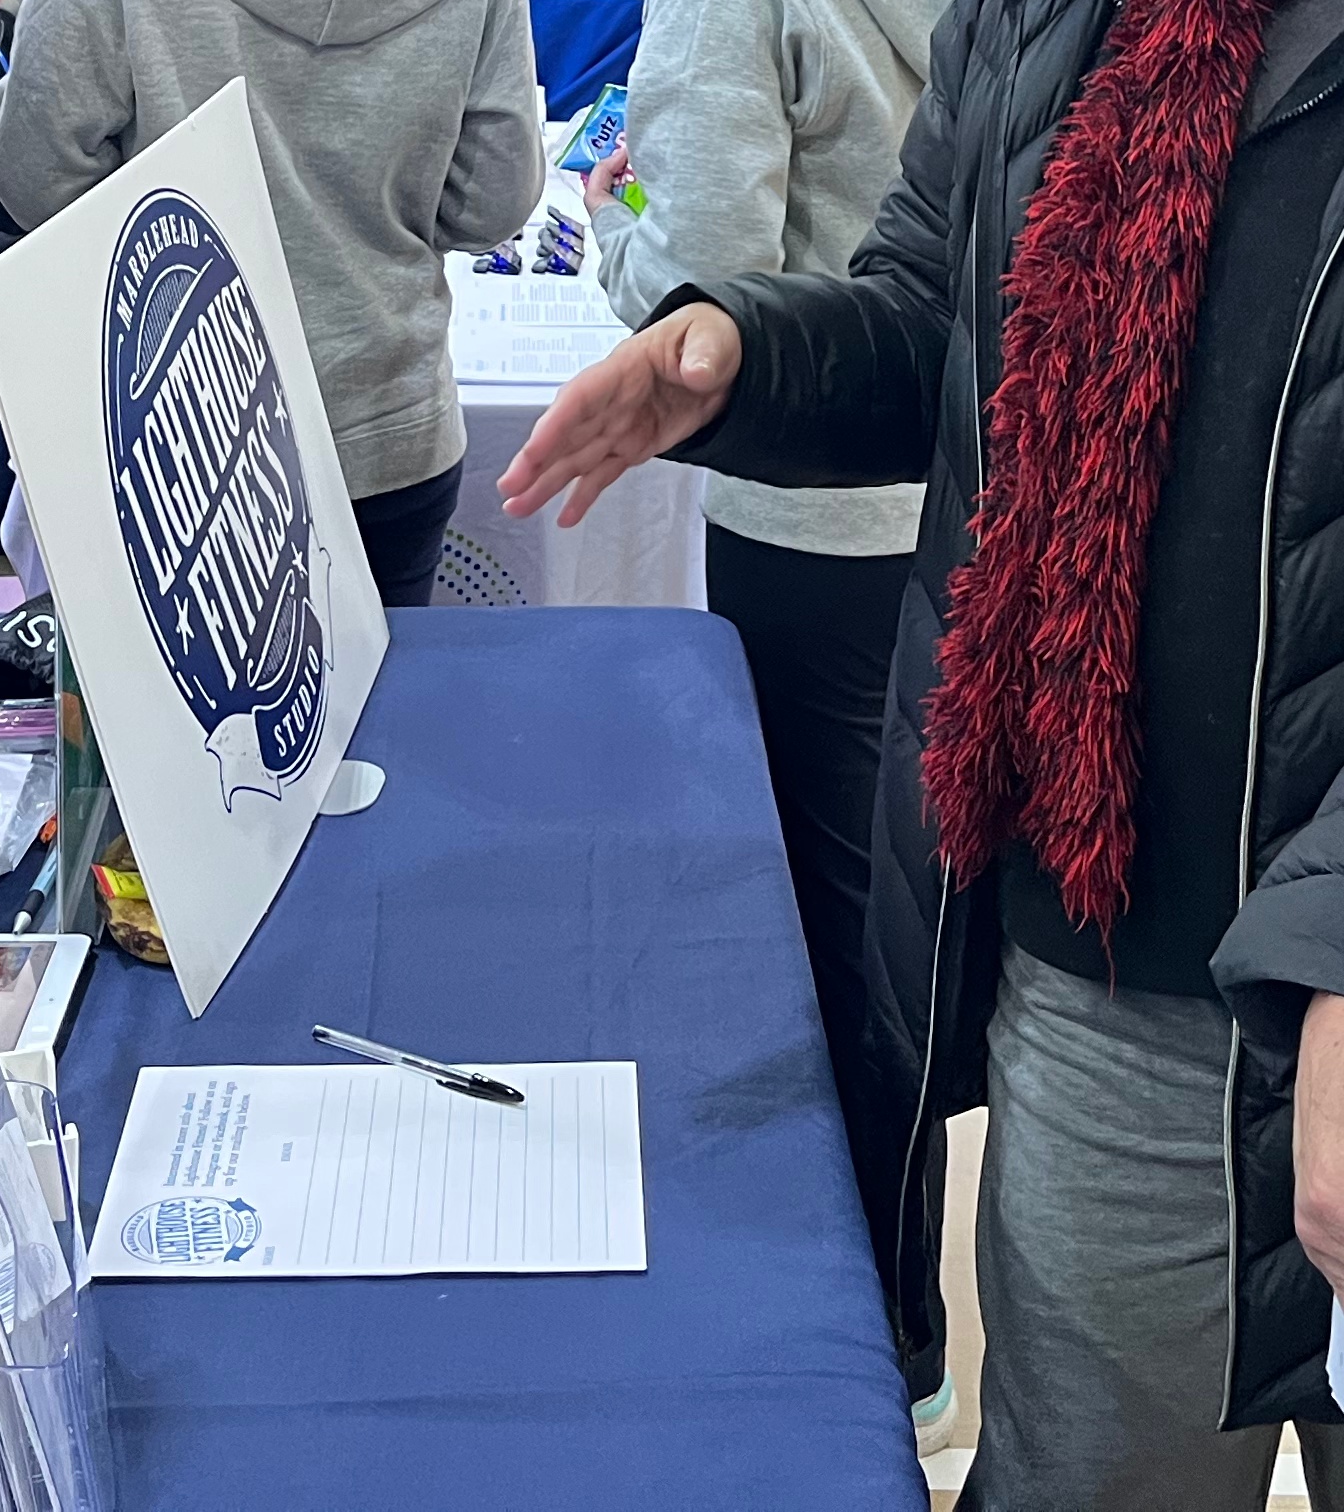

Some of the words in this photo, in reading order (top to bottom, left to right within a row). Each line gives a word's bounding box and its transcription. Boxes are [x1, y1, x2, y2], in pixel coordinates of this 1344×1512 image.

[116, 213, 200, 332] MARBLEHEAD
[119, 275, 268, 596] LIGHTHOUSE
[187, 402, 295, 691] FITNESS
[273, 645, 320, 758] STUDIO
[155, 1200, 192, 1264] LIGHTHOUSE
[189, 1206, 225, 1254] FITNESS
